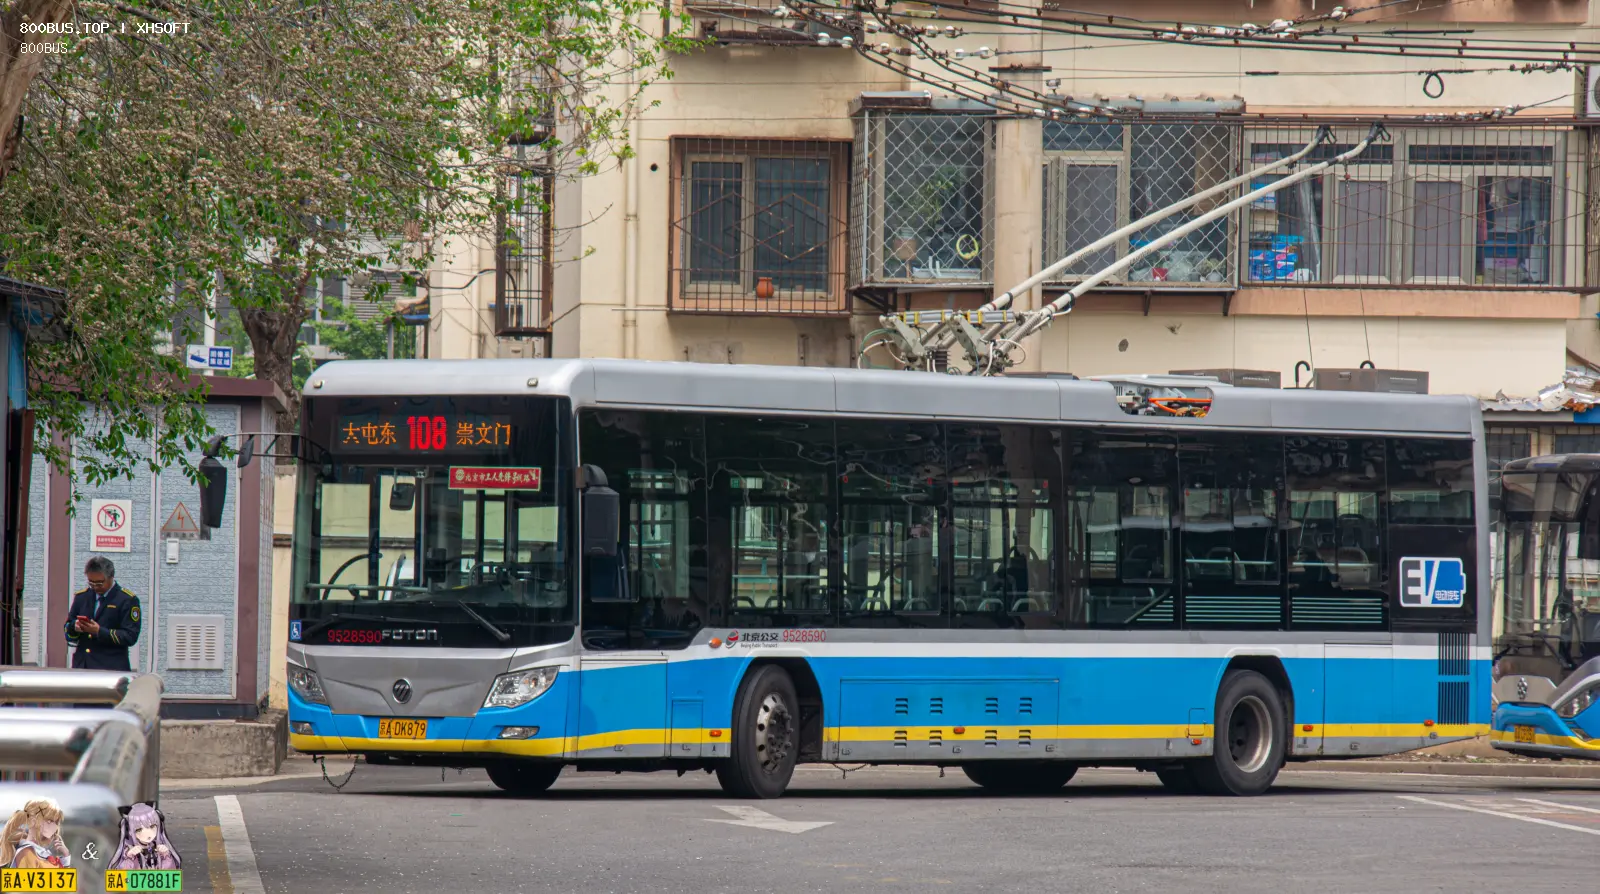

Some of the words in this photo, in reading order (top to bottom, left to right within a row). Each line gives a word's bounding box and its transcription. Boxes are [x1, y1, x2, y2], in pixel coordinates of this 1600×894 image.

[342, 422, 397, 445] 大屯东
[406, 416, 447, 450] 108
[456, 422, 511, 445] 崇文门
[1401, 559, 1440, 605] EV
[327, 629, 382, 643] 9528590
[382, 629, 438, 640] FOTON
[741, 632, 779, 642] 北京公交
[782, 629, 827, 642] 9528590
